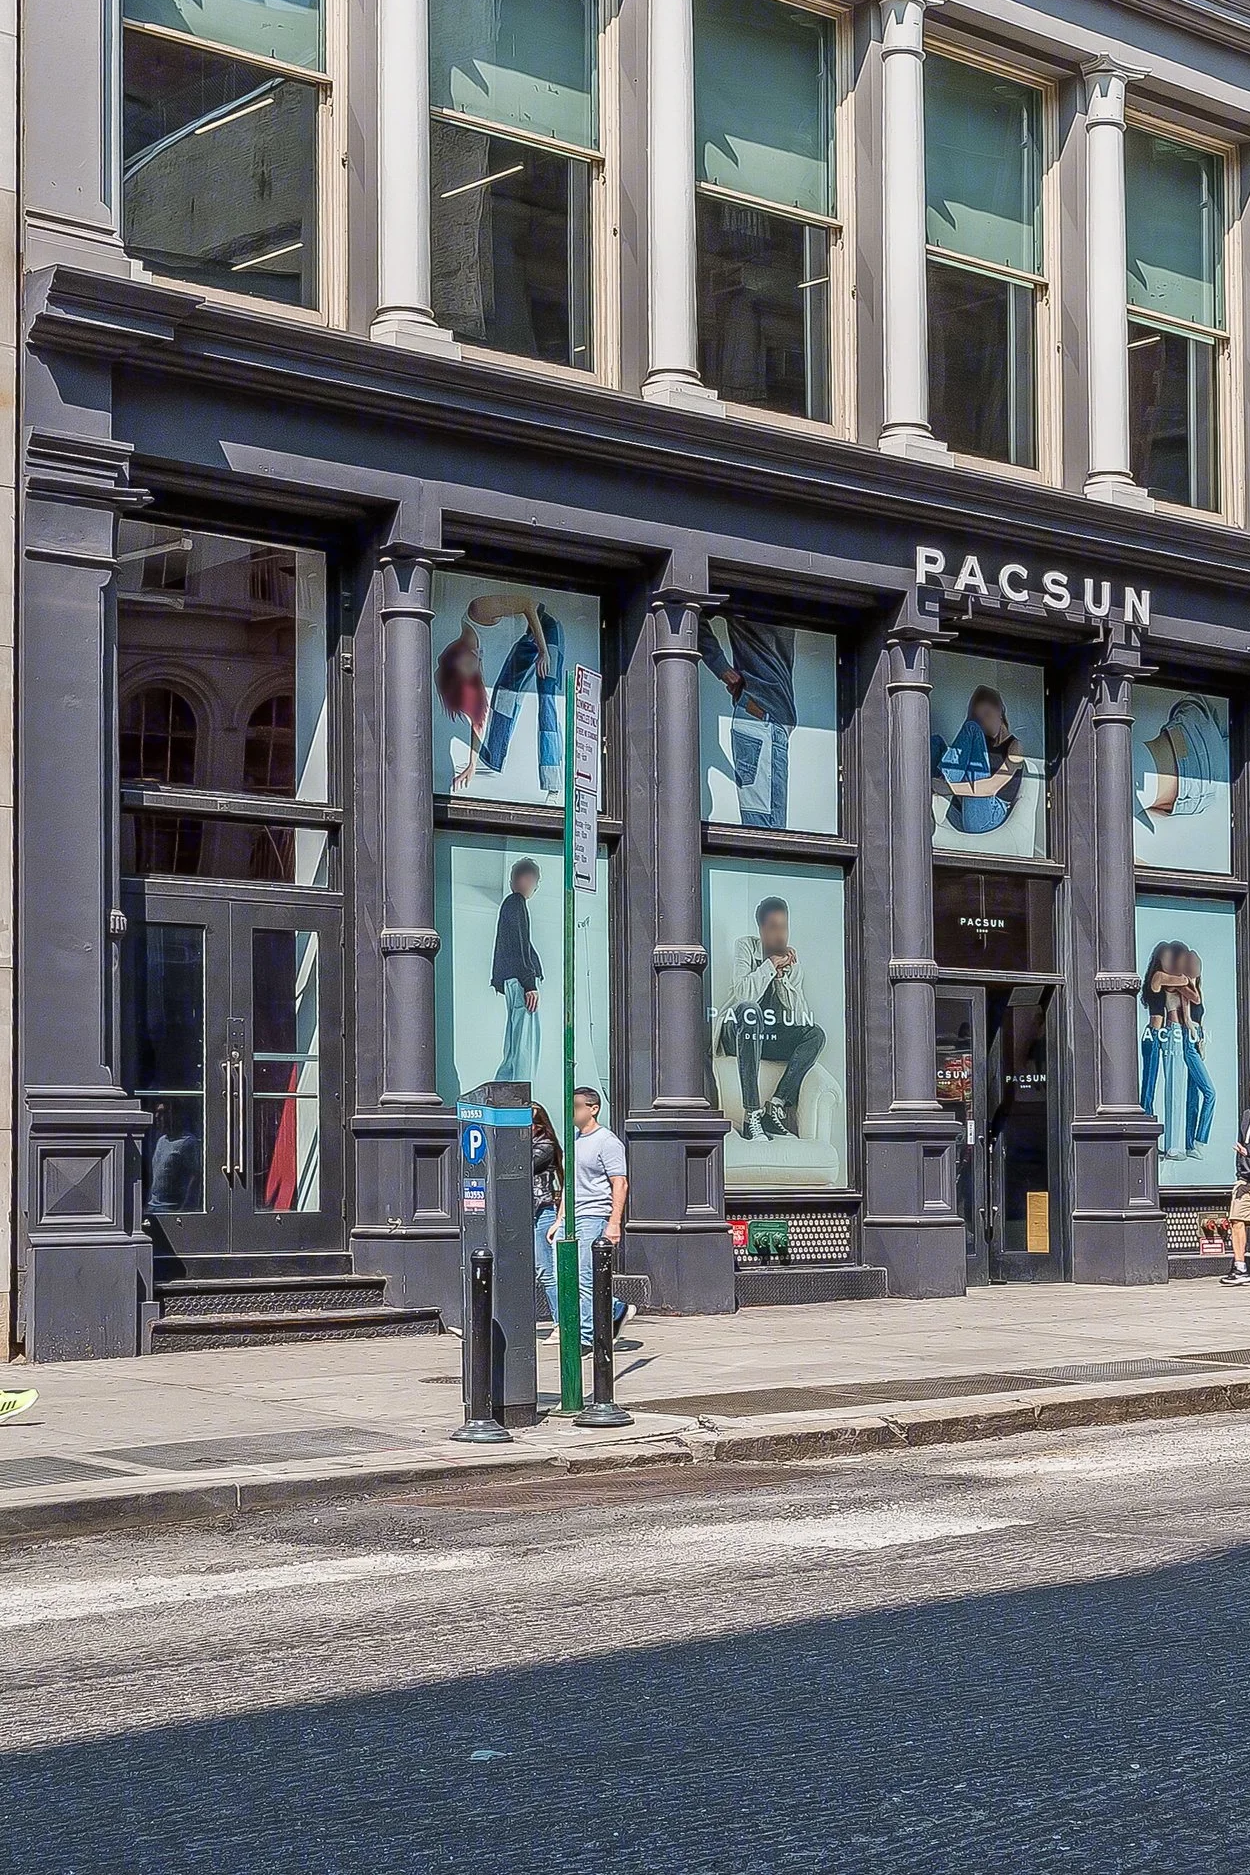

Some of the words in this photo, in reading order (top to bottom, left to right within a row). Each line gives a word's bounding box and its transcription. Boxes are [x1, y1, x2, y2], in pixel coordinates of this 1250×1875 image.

[915, 546, 1151, 626] PACSUN
[960, 917, 1005, 928] PACSUN
[706, 1007, 815, 1028] PACSUN
[745, 1033, 777, 1041] DENIM
[1142, 1027, 1213, 1044] ACSUN
[1005, 1074, 1047, 1083] PACSUN
[469, 1129, 483, 1159] P
